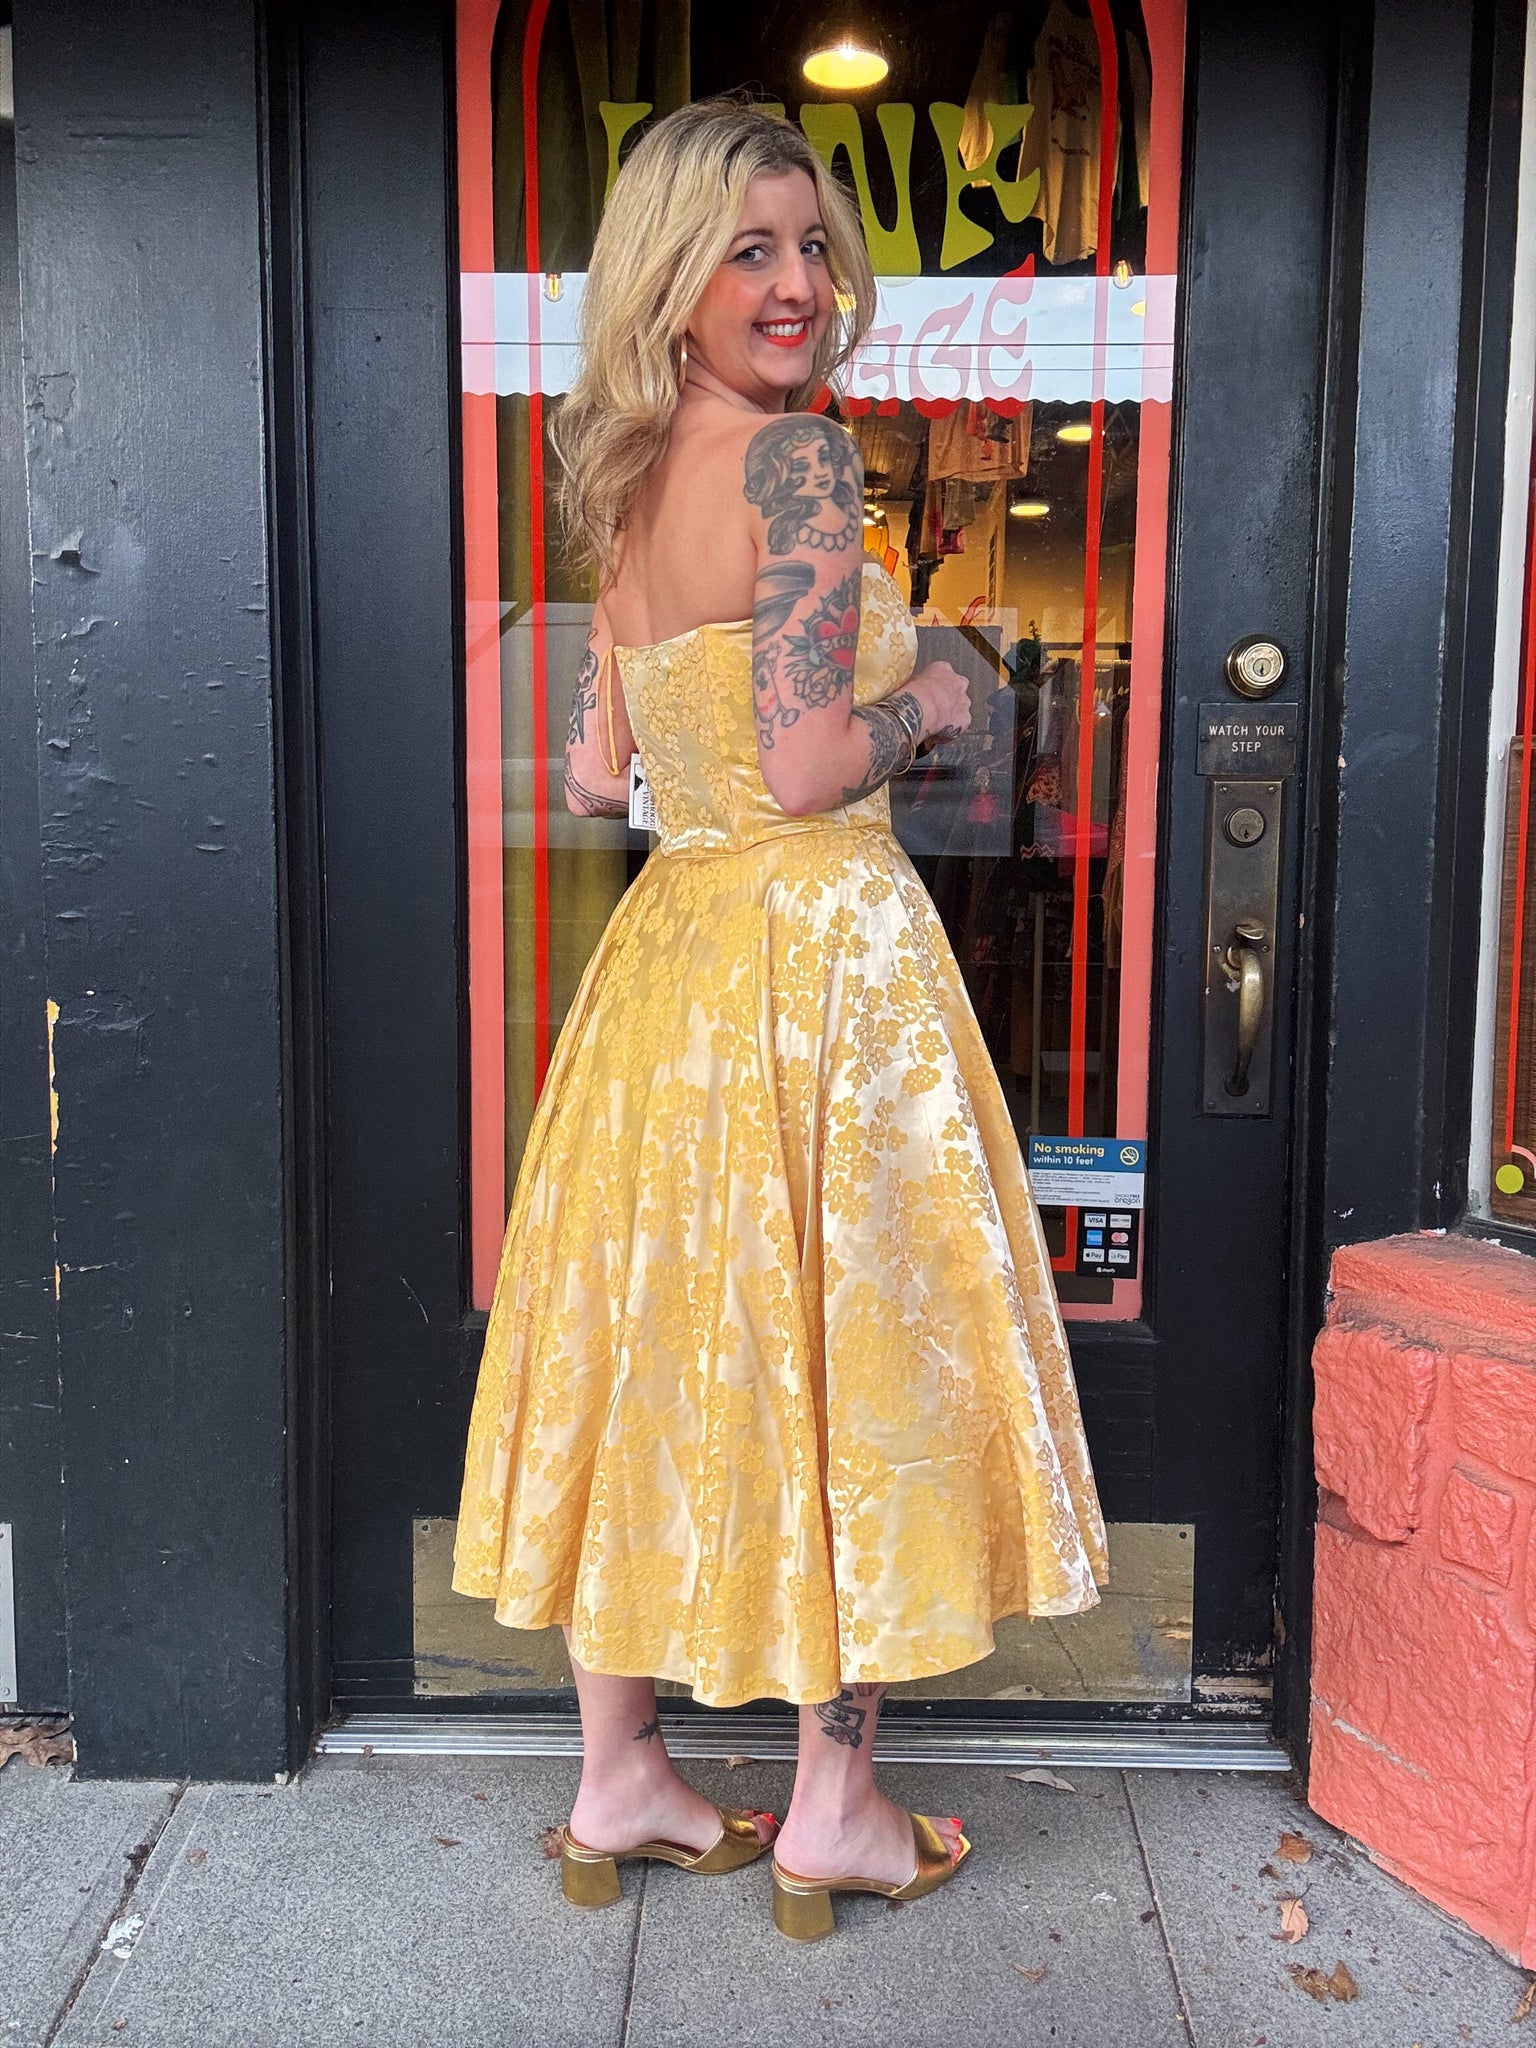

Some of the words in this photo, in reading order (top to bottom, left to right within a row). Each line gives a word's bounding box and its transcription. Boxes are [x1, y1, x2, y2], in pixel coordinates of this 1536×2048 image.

[1208, 725, 1248, 736] WATCH
[1255, 725, 1285, 736] YOUR
[1231, 741, 1262, 752] STEP
[1034, 1142, 1052, 1153] No
[1055, 1143, 1105, 1157] smoking
[1033, 1154, 1061, 1164] within
[1064, 1155, 1073, 1164] 10
[1076, 1156, 1094, 1165] feet
[1091, 1250, 1102, 1259] Pay
